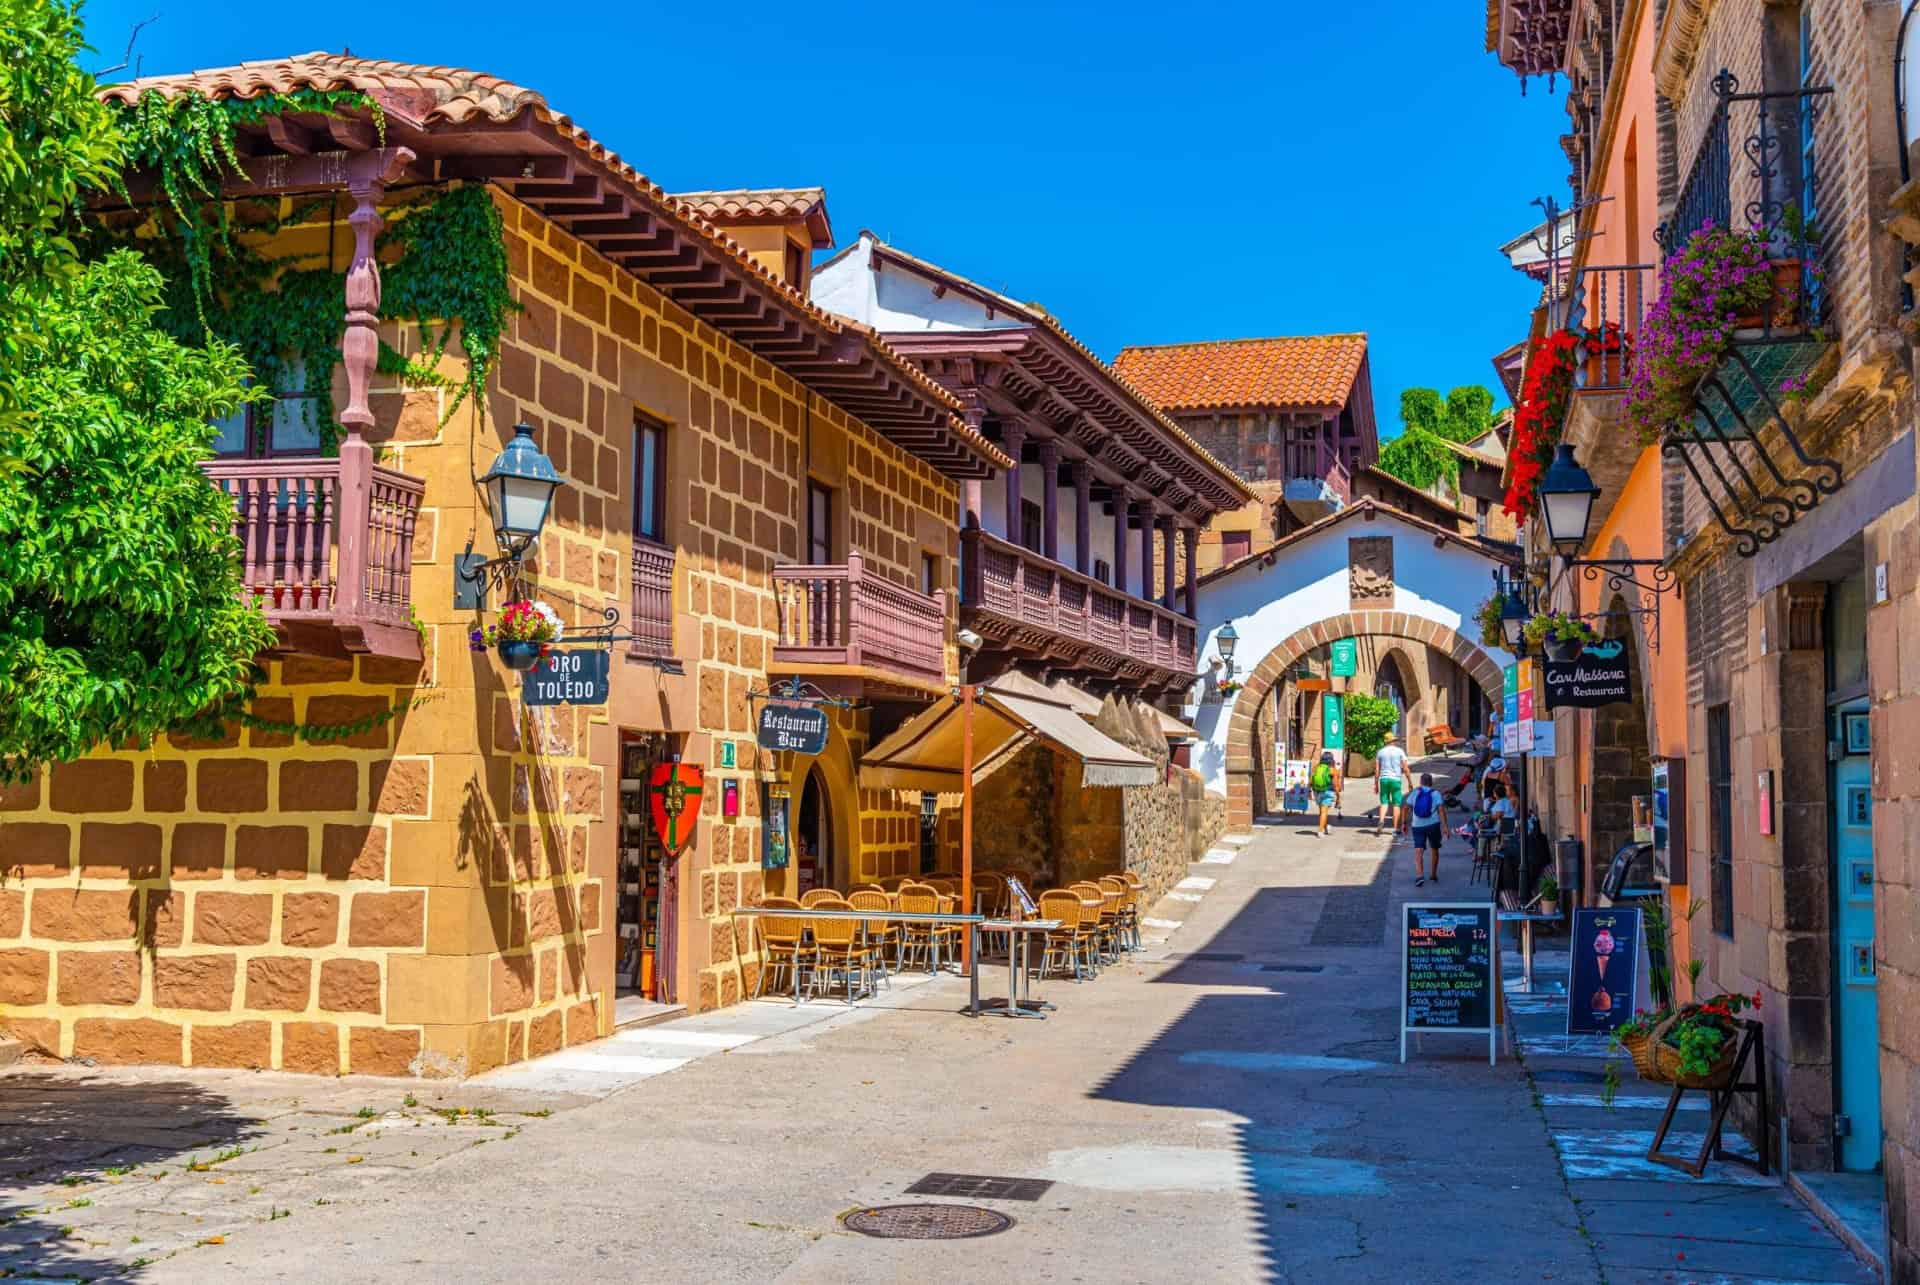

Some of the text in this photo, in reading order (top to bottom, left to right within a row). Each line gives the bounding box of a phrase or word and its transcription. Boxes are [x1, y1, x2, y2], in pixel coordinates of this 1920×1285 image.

[551, 655, 581, 672] ORO
[559, 673, 571, 682] DE
[537, 681, 594, 699] TOLEDO
[1573, 685, 1625, 697] Restaurant
[763, 709, 821, 733] Restaurant
[777, 731, 807, 748] Bar
